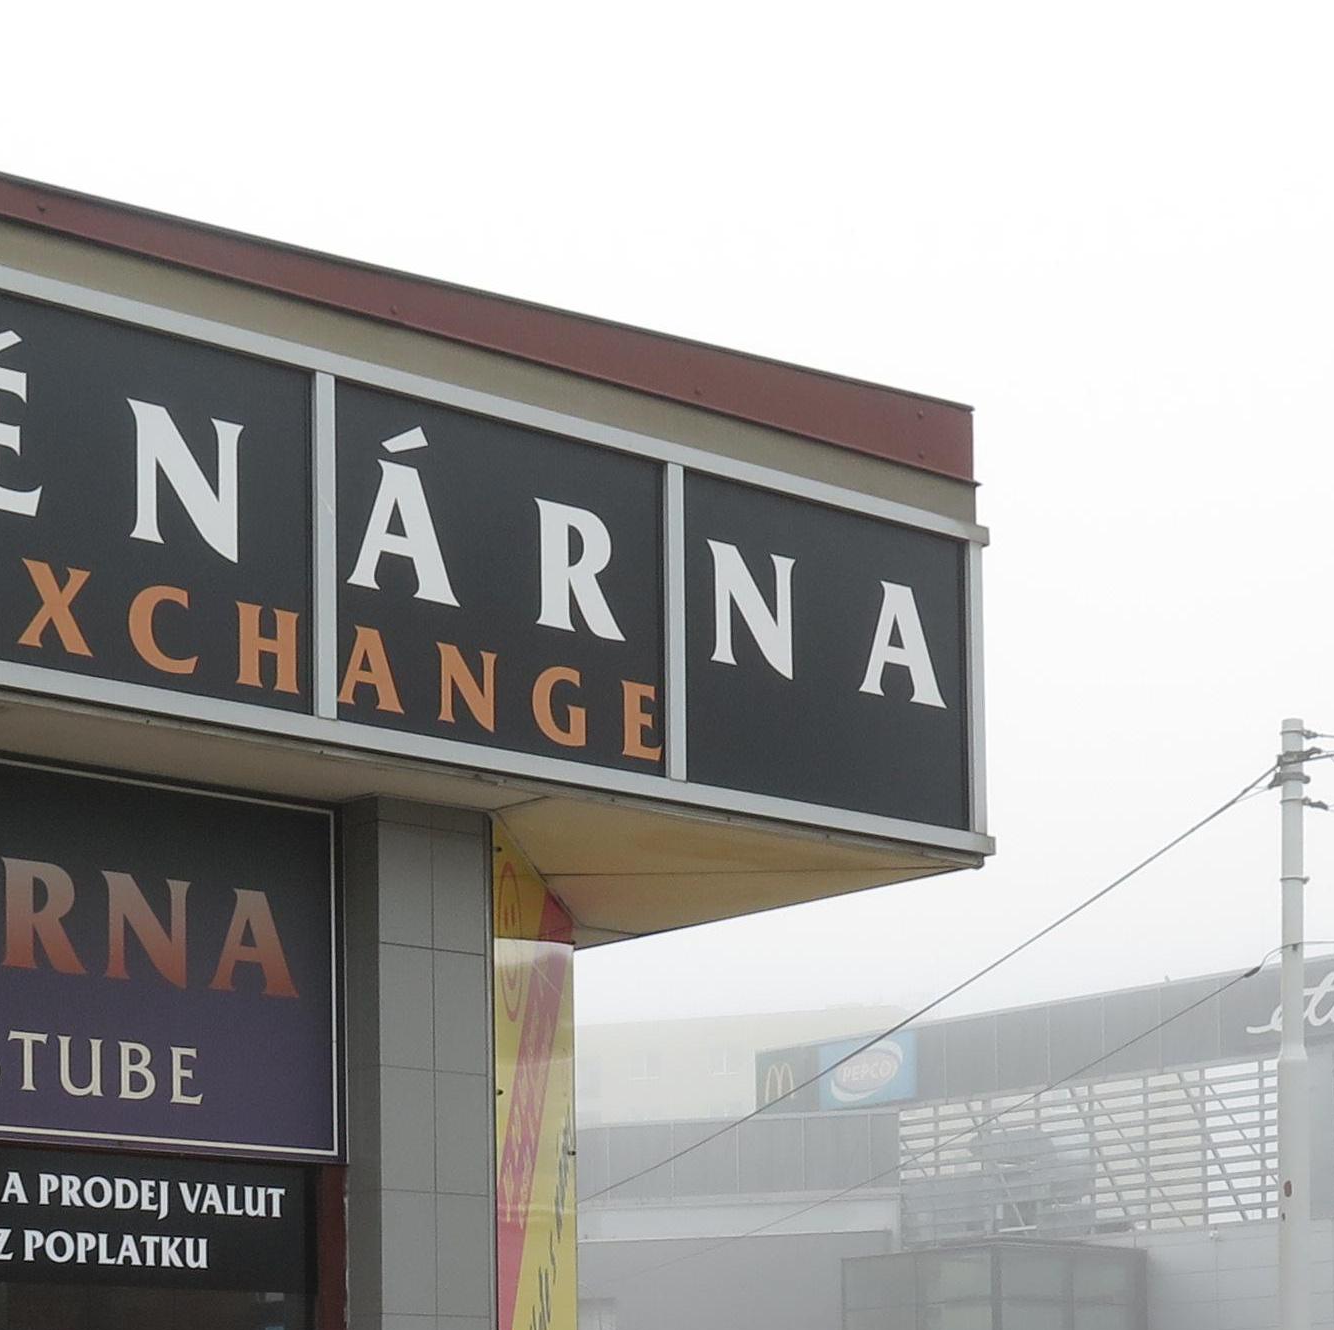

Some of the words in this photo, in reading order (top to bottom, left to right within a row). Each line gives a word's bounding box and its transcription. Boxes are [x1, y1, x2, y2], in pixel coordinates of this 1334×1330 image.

[841, 1058, 893, 1083] PEPCO
[1, 1172, 28, 1203] A
[40, 1174, 168, 1219] PRODEJ
[179, 1183, 285, 1217] VALUT
[24, 1230, 207, 1268] POPLATKU
